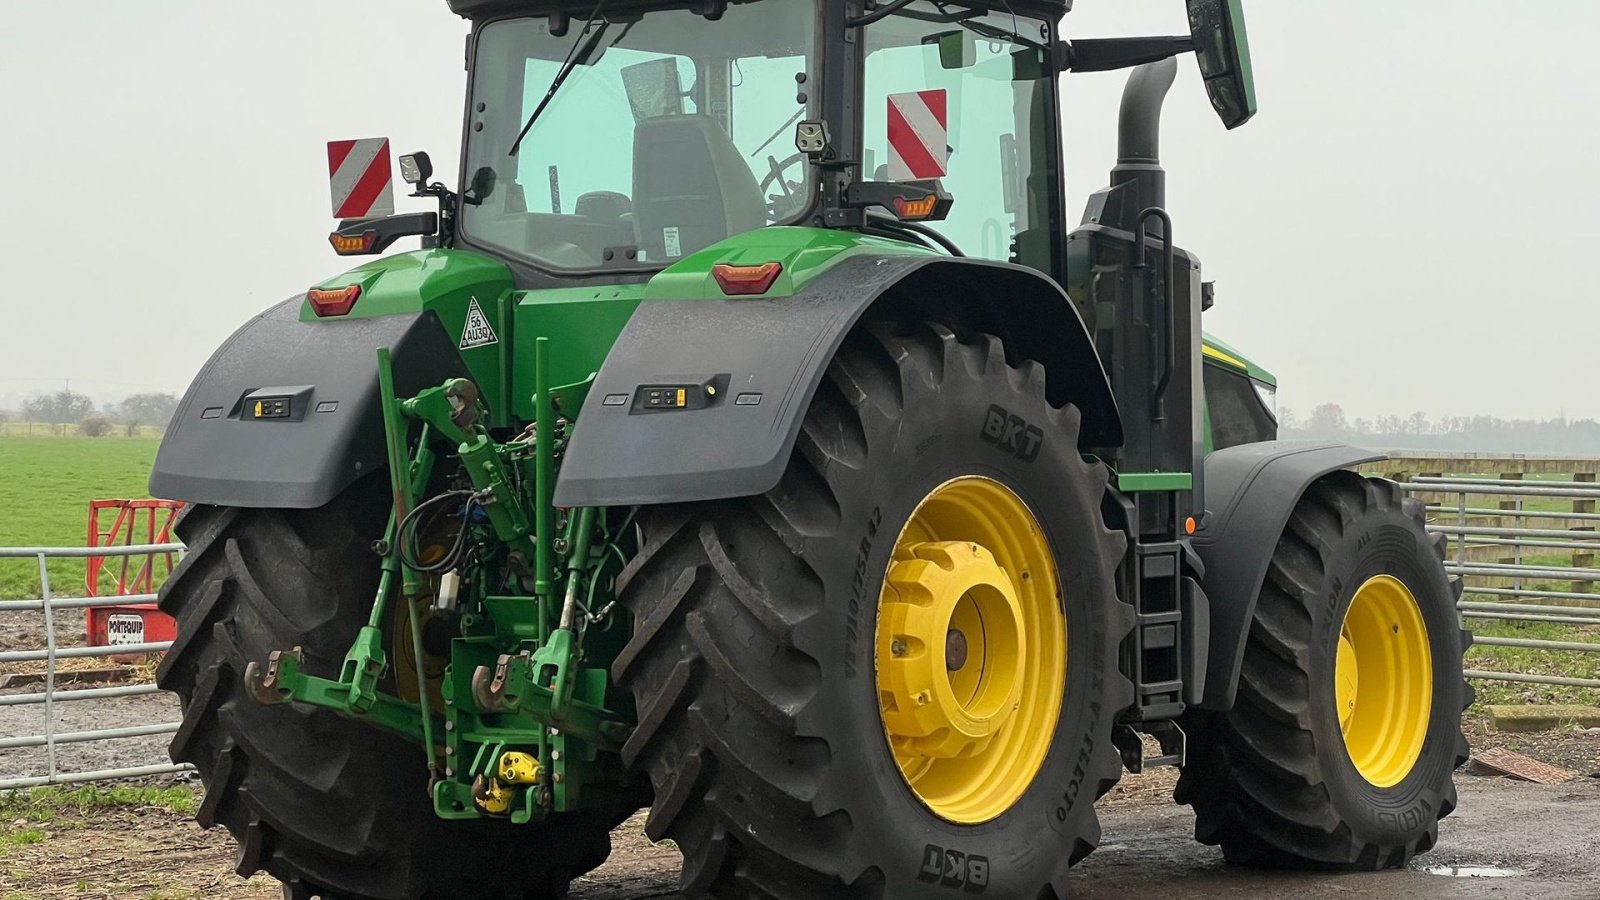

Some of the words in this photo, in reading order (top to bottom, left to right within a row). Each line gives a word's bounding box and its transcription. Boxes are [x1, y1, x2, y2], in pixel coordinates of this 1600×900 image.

[471, 316, 481, 328] 56
[982, 405, 1043, 462] BKT
[109, 620, 142, 634] PORTEQUIP
[919, 845, 989, 891] BKT
